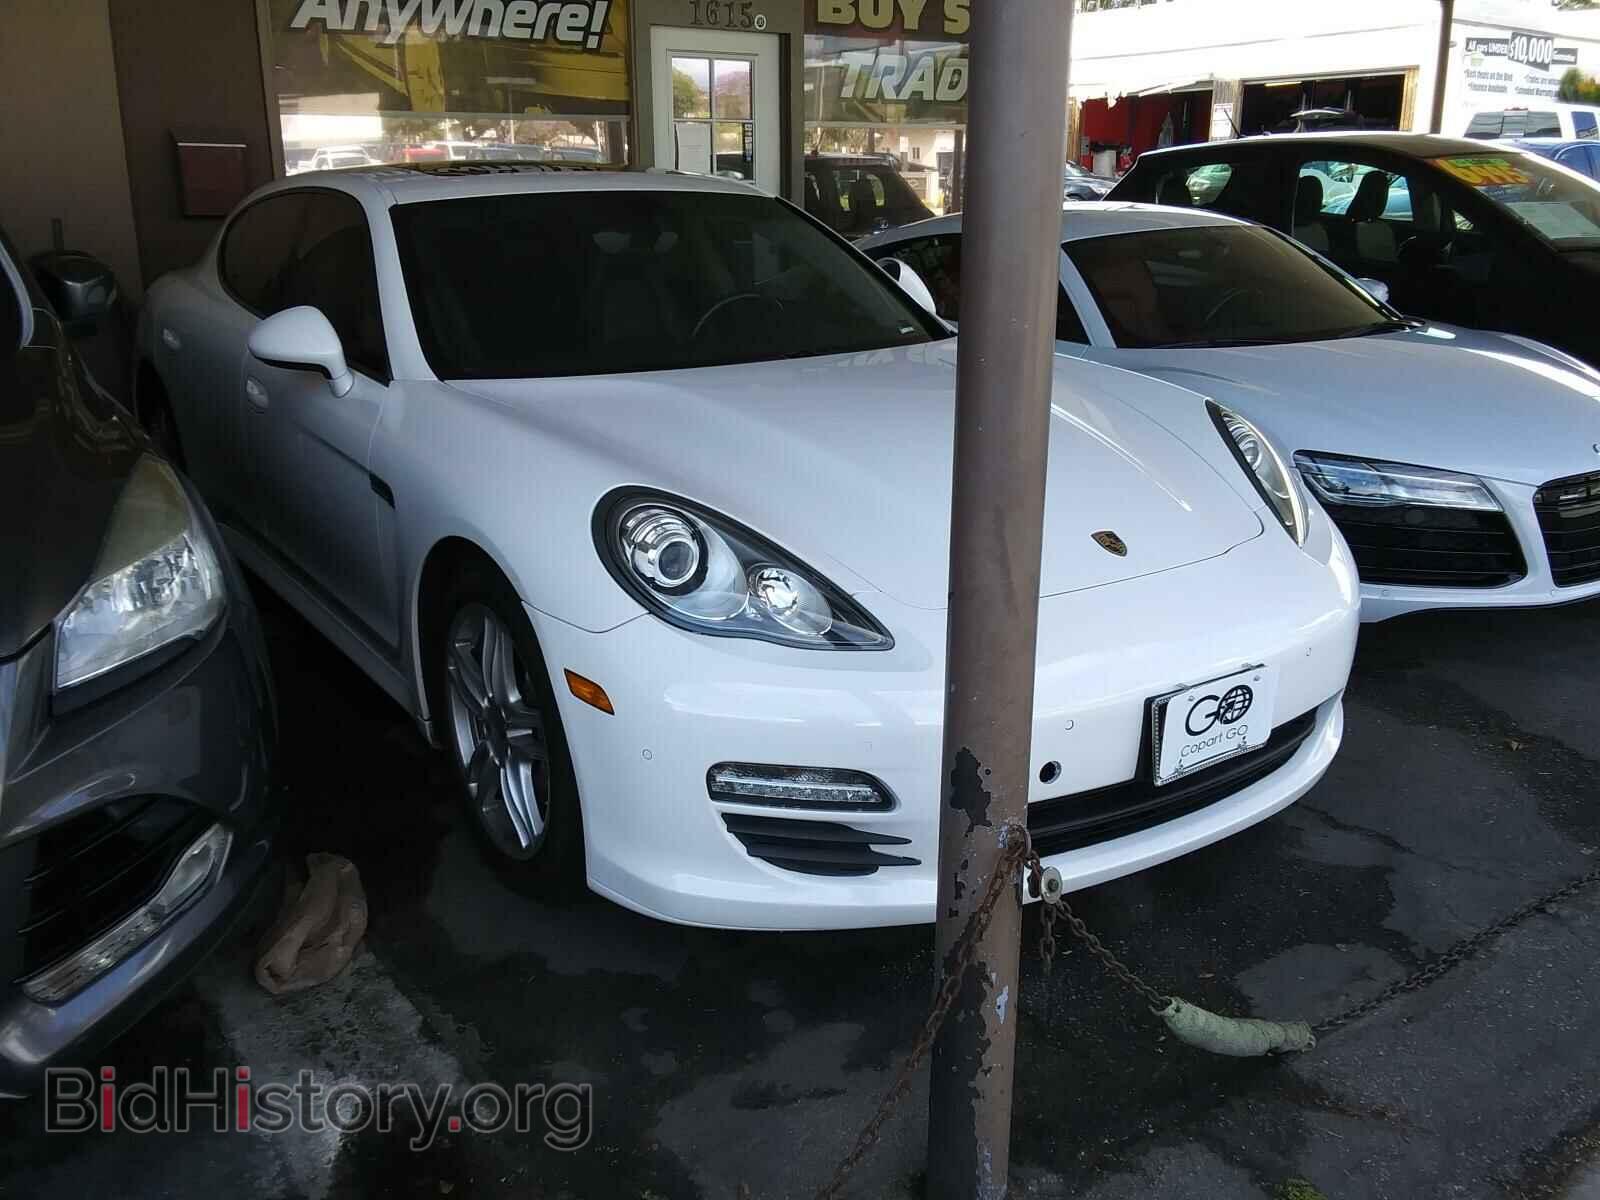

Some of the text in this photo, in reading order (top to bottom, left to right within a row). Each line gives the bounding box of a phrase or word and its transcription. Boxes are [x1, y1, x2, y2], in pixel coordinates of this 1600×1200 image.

[290, 0, 608, 49] Anywhere!
[689, 0, 753, 30] 1615
[817, 0, 926, 31] BUY
[1510, 36, 1553, 65] $10,000
[1181, 724, 1248, 757] Copart GO
